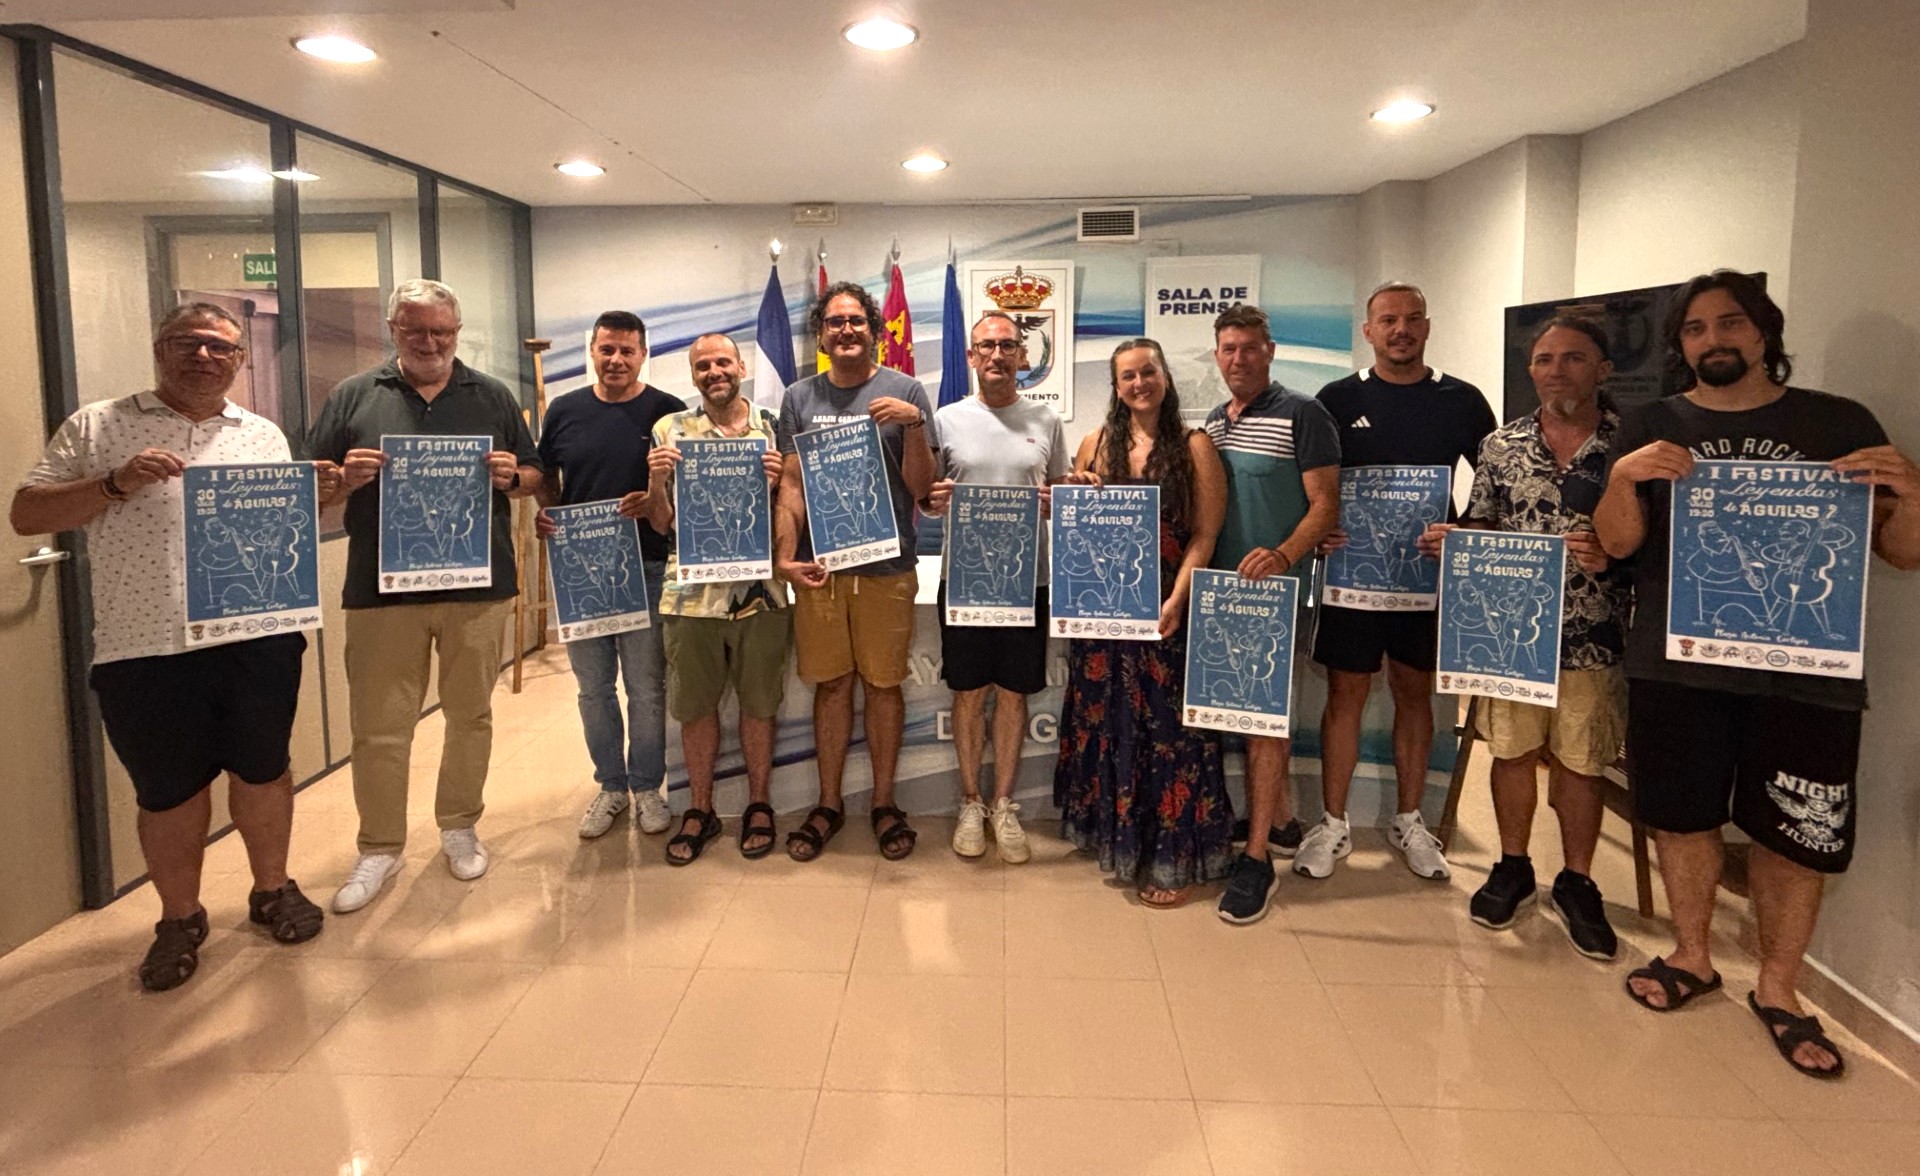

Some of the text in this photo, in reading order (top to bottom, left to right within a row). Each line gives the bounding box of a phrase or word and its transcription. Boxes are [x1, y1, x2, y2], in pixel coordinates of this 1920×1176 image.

[246, 260, 277, 274] SALI
[1157, 286, 1248, 300] SALA DE
[1742, 437, 1806, 461] ROCK
[1710, 466, 1720, 479] I
[198, 489, 215, 501] 30
[219, 479, 297, 497] Leyendas
[1691, 488, 1714, 501] 30
[1719, 481, 1838, 501] Leyendas
[1063, 505, 1076, 515] 30
[1078, 500, 1142, 514] Leyendas
[1454, 552, 1469, 563] 30
[1472, 548, 1545, 564] Leyendas
